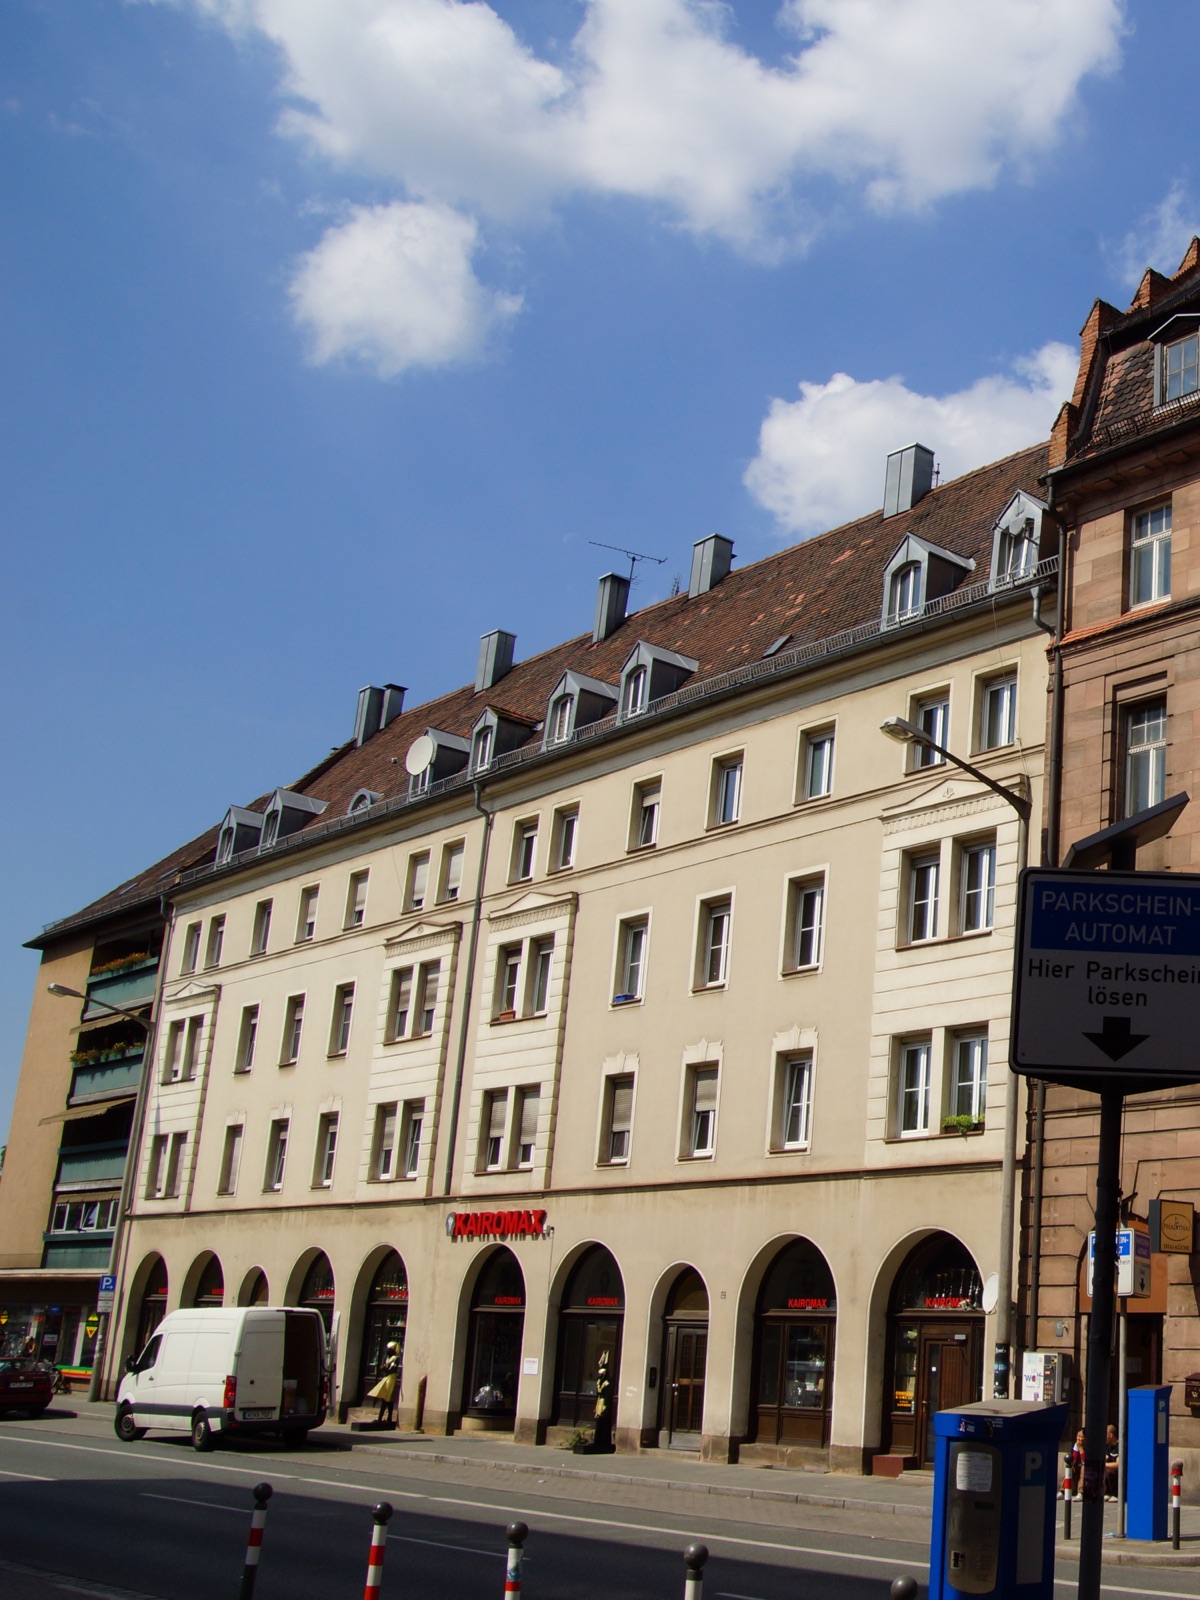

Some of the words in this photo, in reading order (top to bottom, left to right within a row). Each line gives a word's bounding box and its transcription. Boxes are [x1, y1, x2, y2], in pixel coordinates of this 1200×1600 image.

[1064, 922, 1176, 945] AUTOMAT
[1028, 958, 1075, 979] Hier
[1088, 986, 1147, 1007] lösen
[454, 1210, 546, 1236] KAIROMAX
[494, 1296, 521, 1305] KAIROMAX
[587, 1297, 618, 1306] KAIROMAX
[788, 1298, 827, 1308] KAIROMAX
[1025, 1451, 1042, 1480] P
